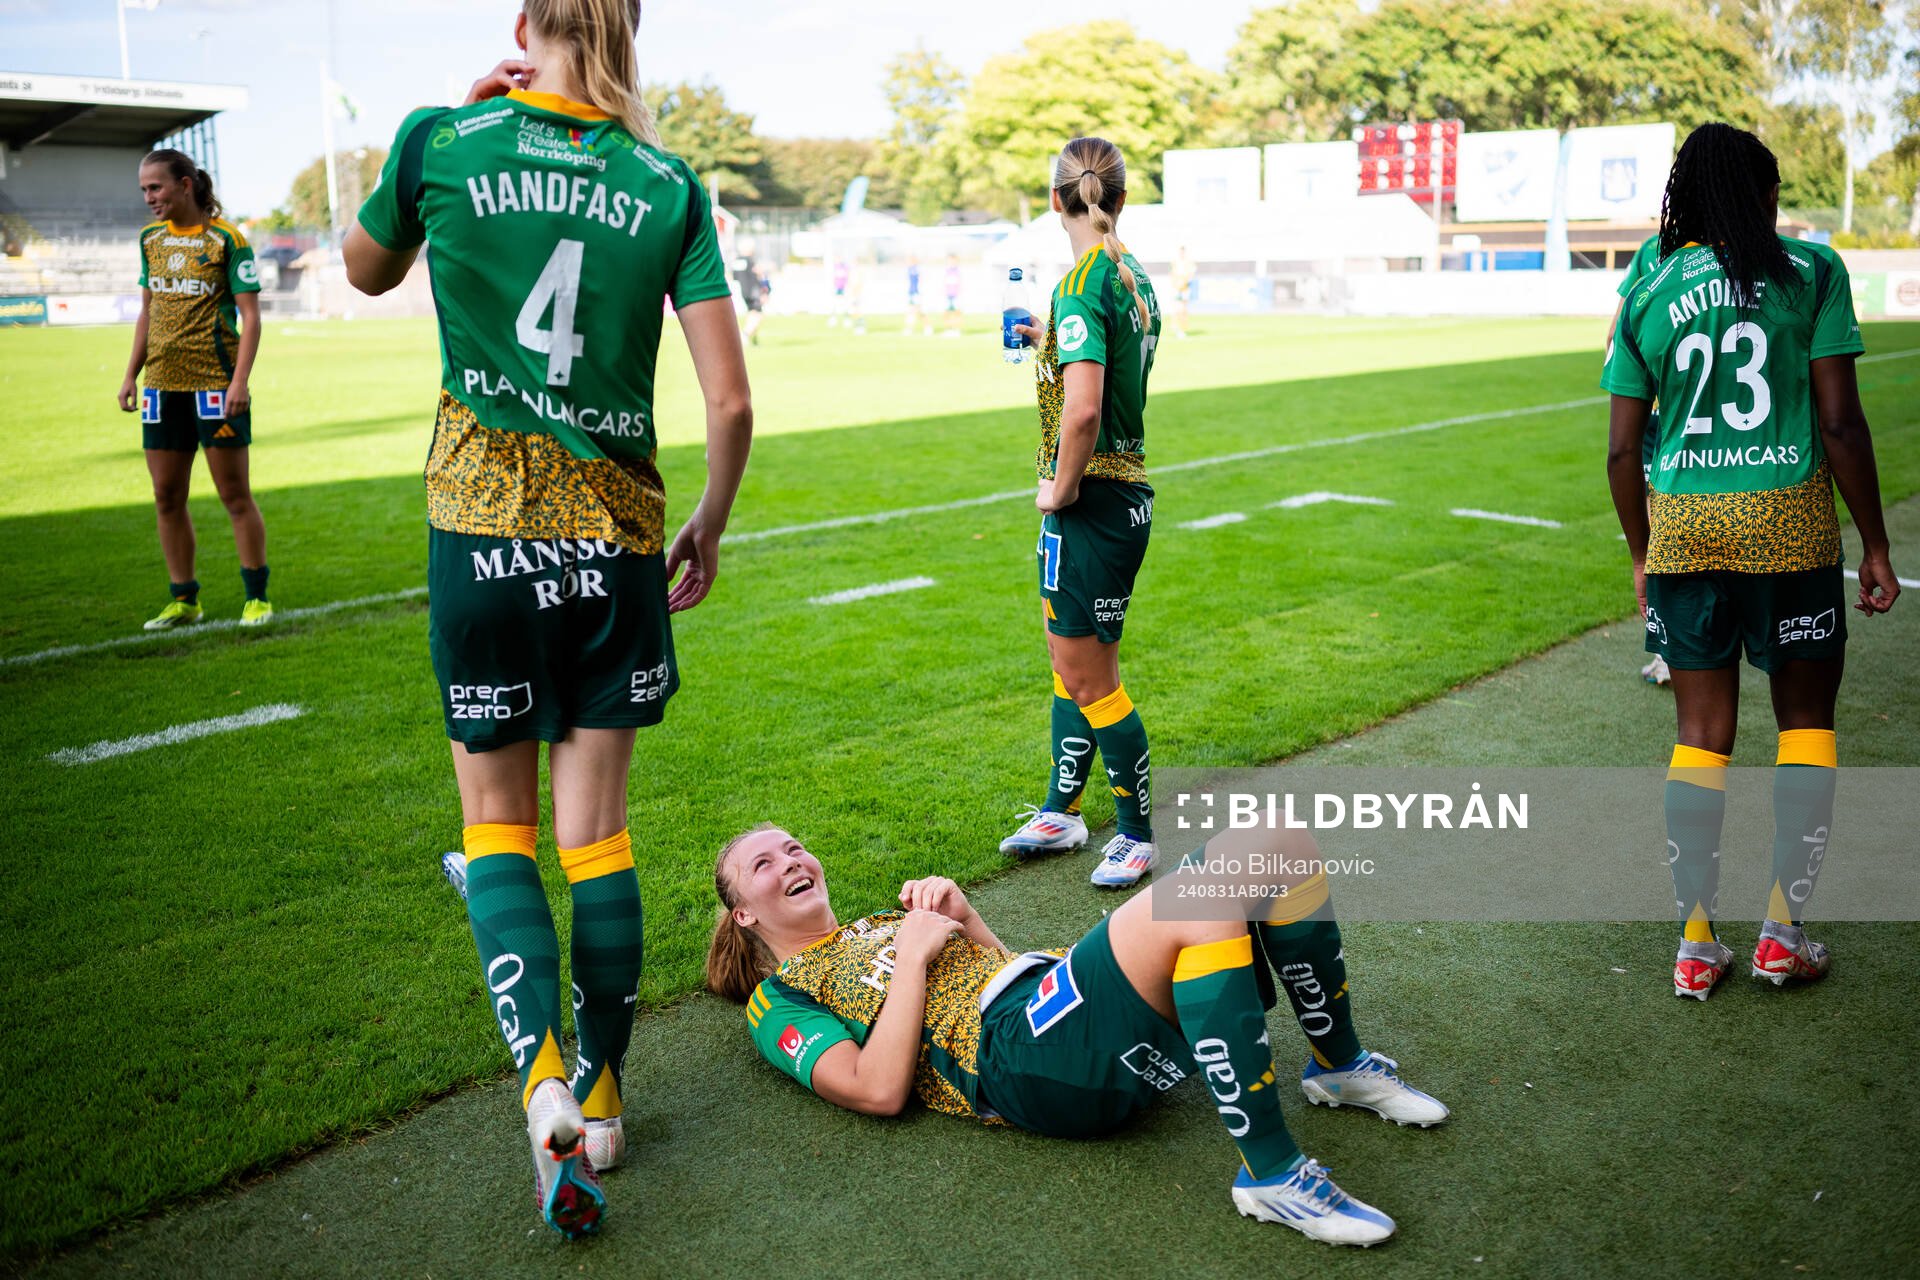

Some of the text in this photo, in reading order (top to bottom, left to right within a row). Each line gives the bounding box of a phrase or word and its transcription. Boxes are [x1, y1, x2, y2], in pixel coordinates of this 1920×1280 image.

[516, 129, 569, 151] create
[519, 115, 556, 137] Let's
[516, 141, 607, 171] Norrköping
[467, 170, 652, 237] HANDFAST
[516, 238, 584, 387] 4
[1675, 321, 1771, 438] 23
[1660, 445, 1799, 473] PLATINUMCARS
[470, 538, 633, 581] MÅNSSO
[531, 565, 608, 610] RÖR
[1095, 597, 1121, 611] pre
[1779, 615, 1813, 635] pre
[1779, 628, 1825, 645] zero
[631, 663, 665, 688] pre
[450, 684, 494, 702] pre
[451, 702, 513, 719] zero
[1057, 736, 1092, 794] Ocab
[1789, 825, 1828, 903] Ocab
[488, 952, 537, 1069] Ocab
[1276, 961, 1334, 1037] Ocab
[805, 1032, 824, 1046] SPEL
[1143, 1070, 1175, 1090] pre
[1148, 1050, 1186, 1081] zero
[1192, 1037, 1251, 1138] Ocab
